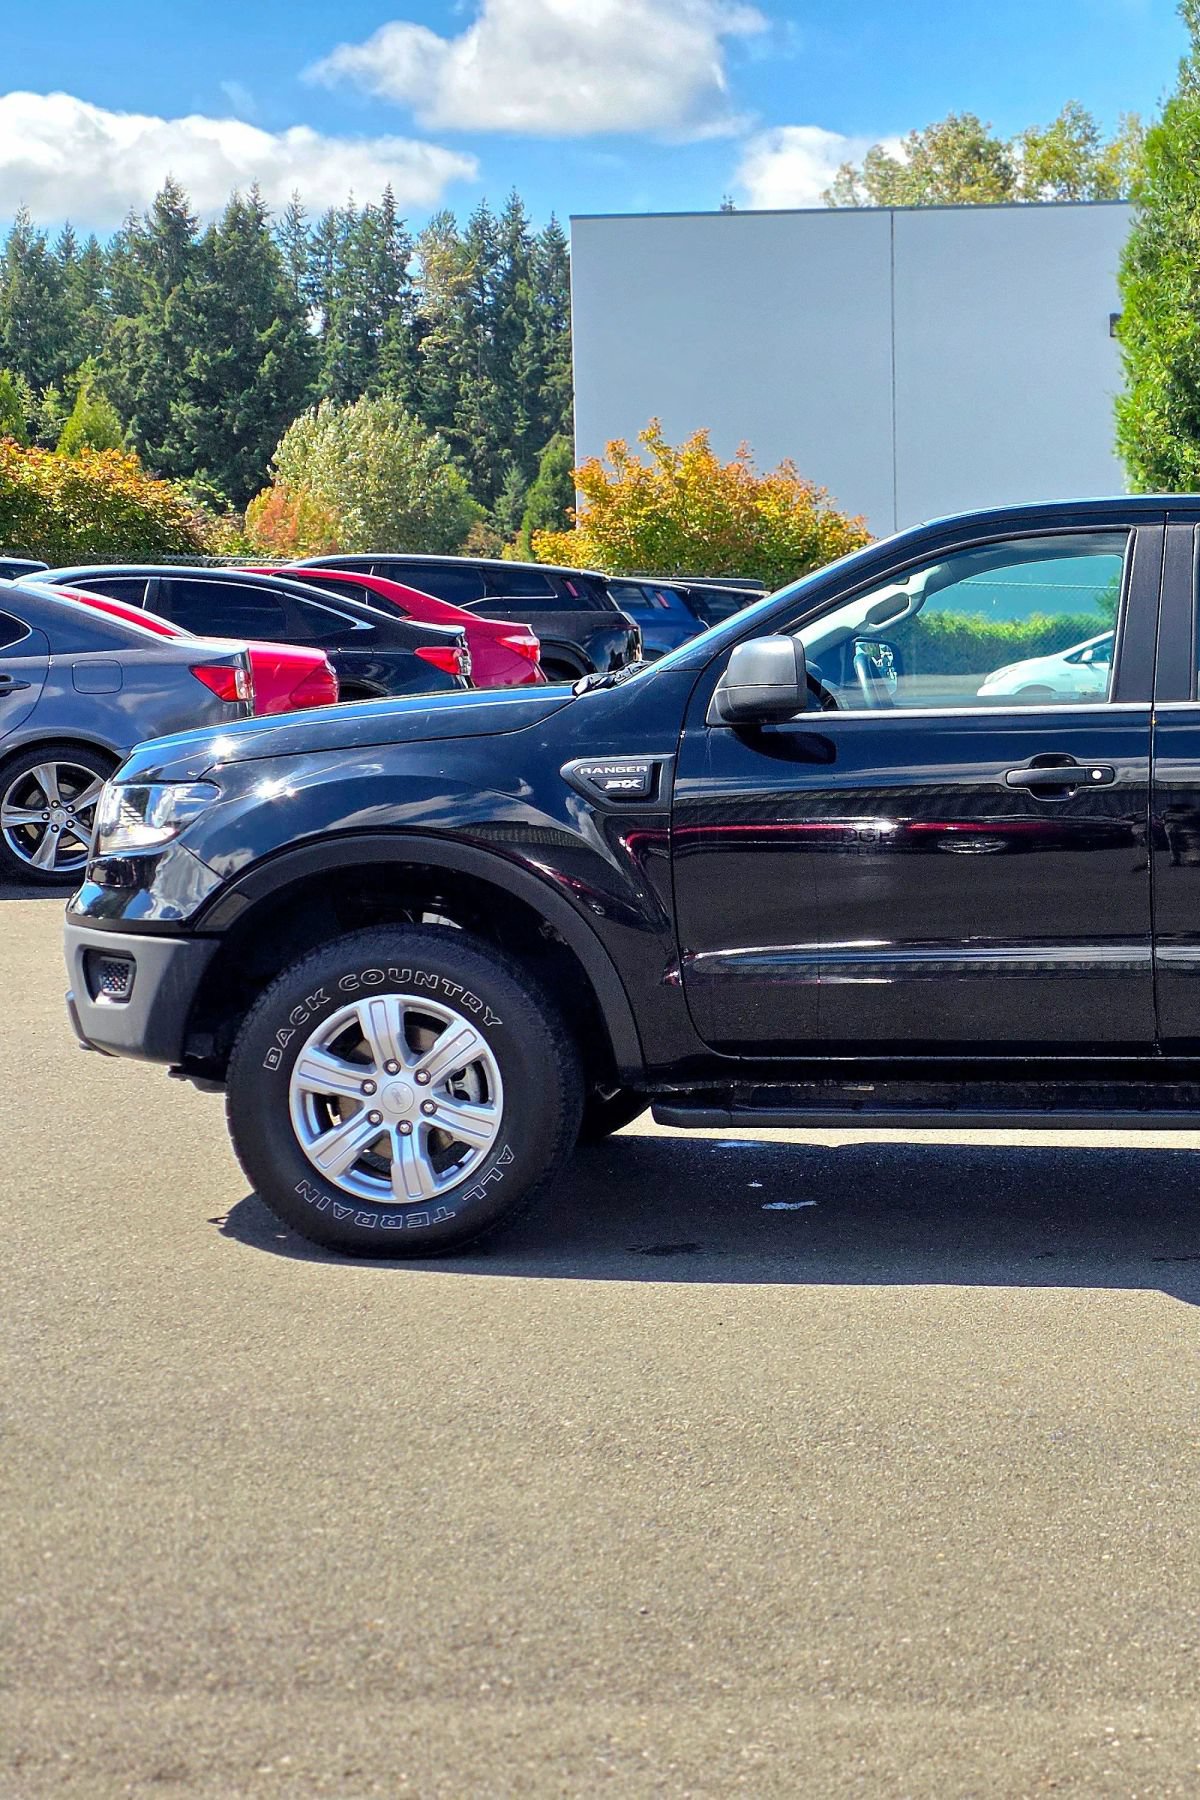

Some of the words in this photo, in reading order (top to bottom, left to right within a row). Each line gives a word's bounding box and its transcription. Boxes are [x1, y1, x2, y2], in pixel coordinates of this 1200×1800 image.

[580, 765, 648, 775] RANGER
[263, 989, 331, 1071] BACK
[338, 968, 503, 1027] COUNTRY
[462, 1144, 515, 1202] ALL
[294, 1178, 456, 1229] TERRAIN
